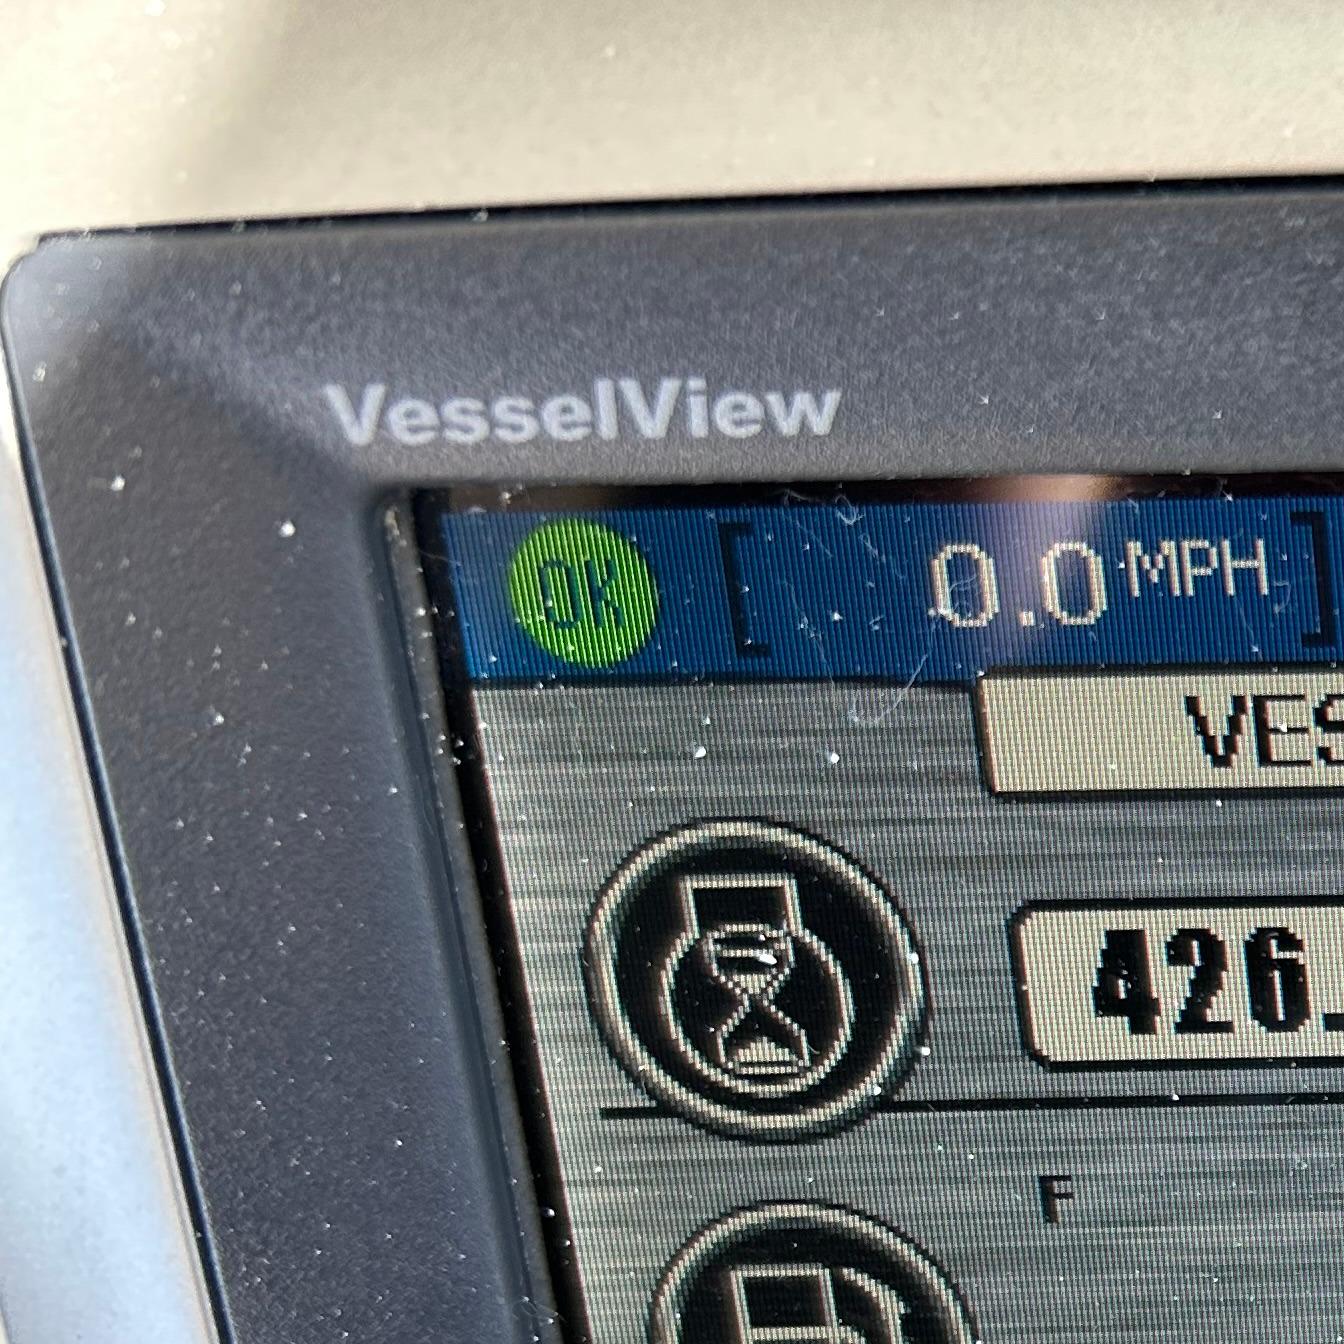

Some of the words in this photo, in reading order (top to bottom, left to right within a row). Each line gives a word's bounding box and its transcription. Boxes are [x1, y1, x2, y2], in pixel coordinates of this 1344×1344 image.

[325, 377, 842, 446] VesselView
[535, 557, 627, 630] OK
[928, 540, 1110, 628] 0.0
[1122, 538, 1272, 597] MPH
[1037, 1174, 1073, 1223] F
